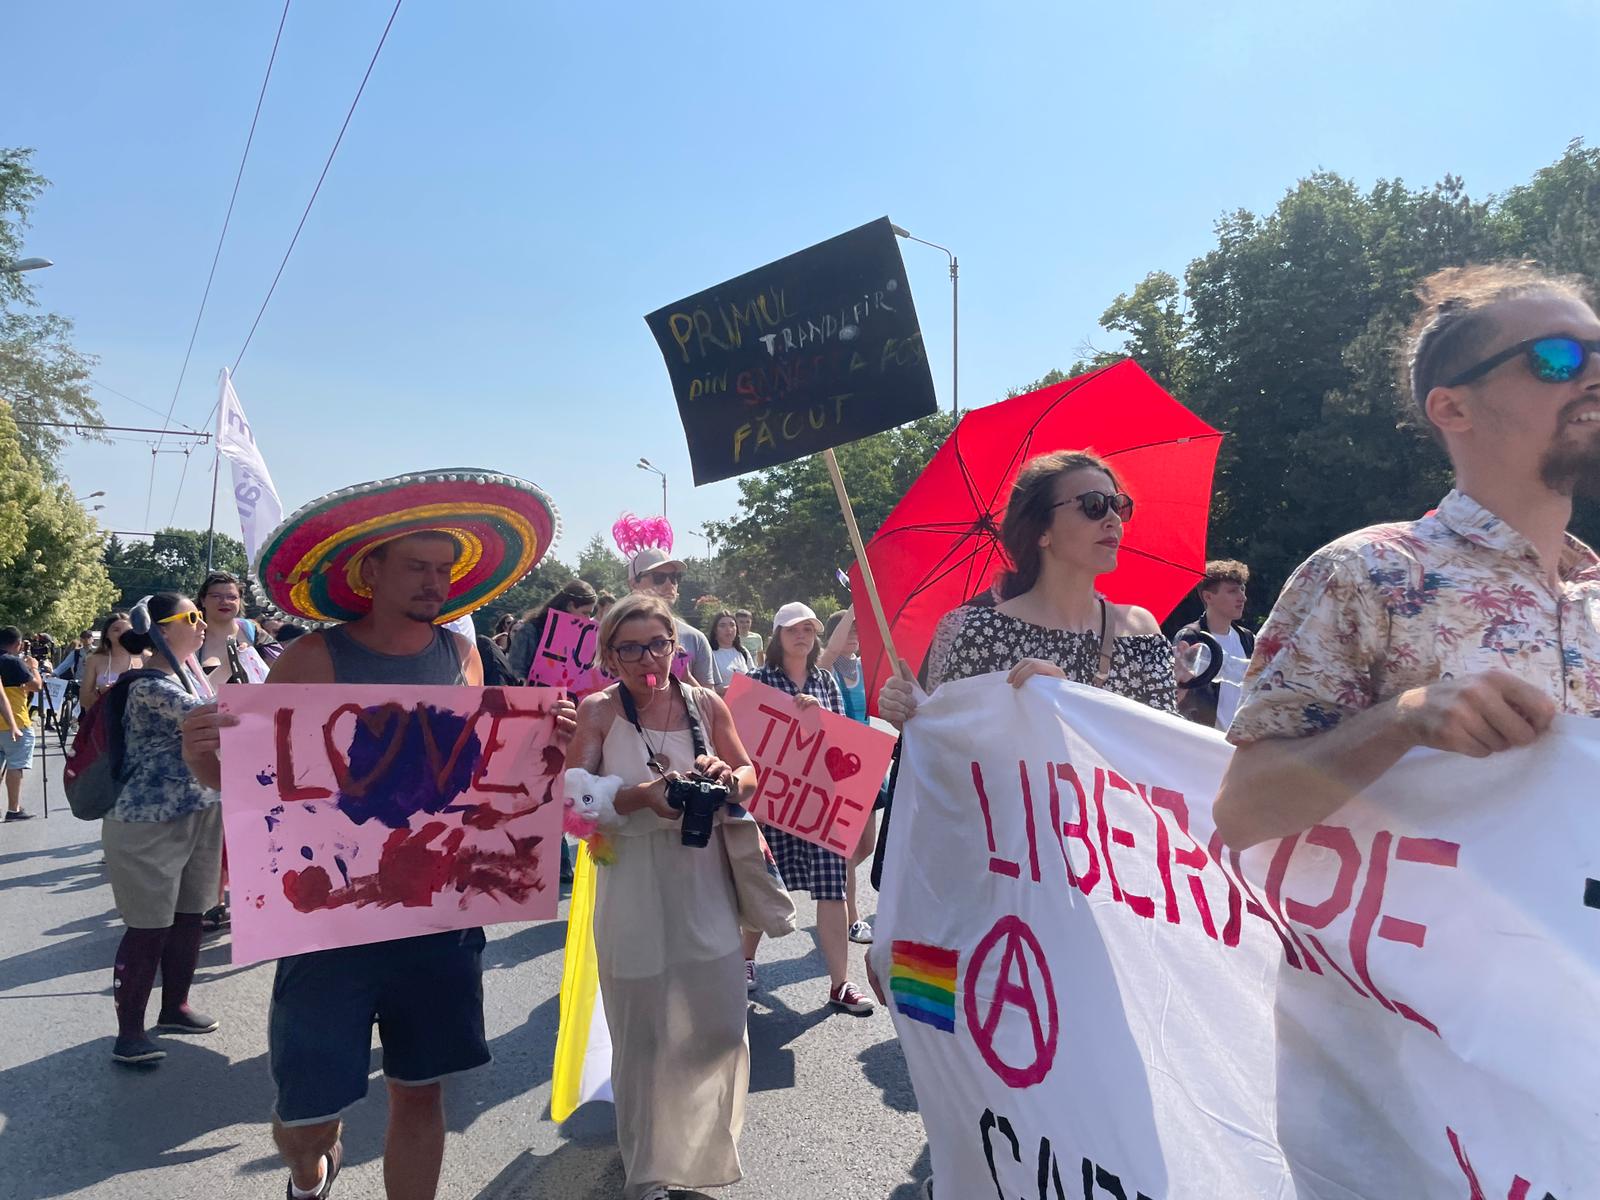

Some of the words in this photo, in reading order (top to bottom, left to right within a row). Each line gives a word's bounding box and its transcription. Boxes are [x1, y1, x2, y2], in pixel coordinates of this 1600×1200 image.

[732, 393, 854, 465] FĂCUT
[274, 698, 548, 802] LOVE
[755, 703, 826, 777] TM
[748, 759, 865, 851] RiDE
